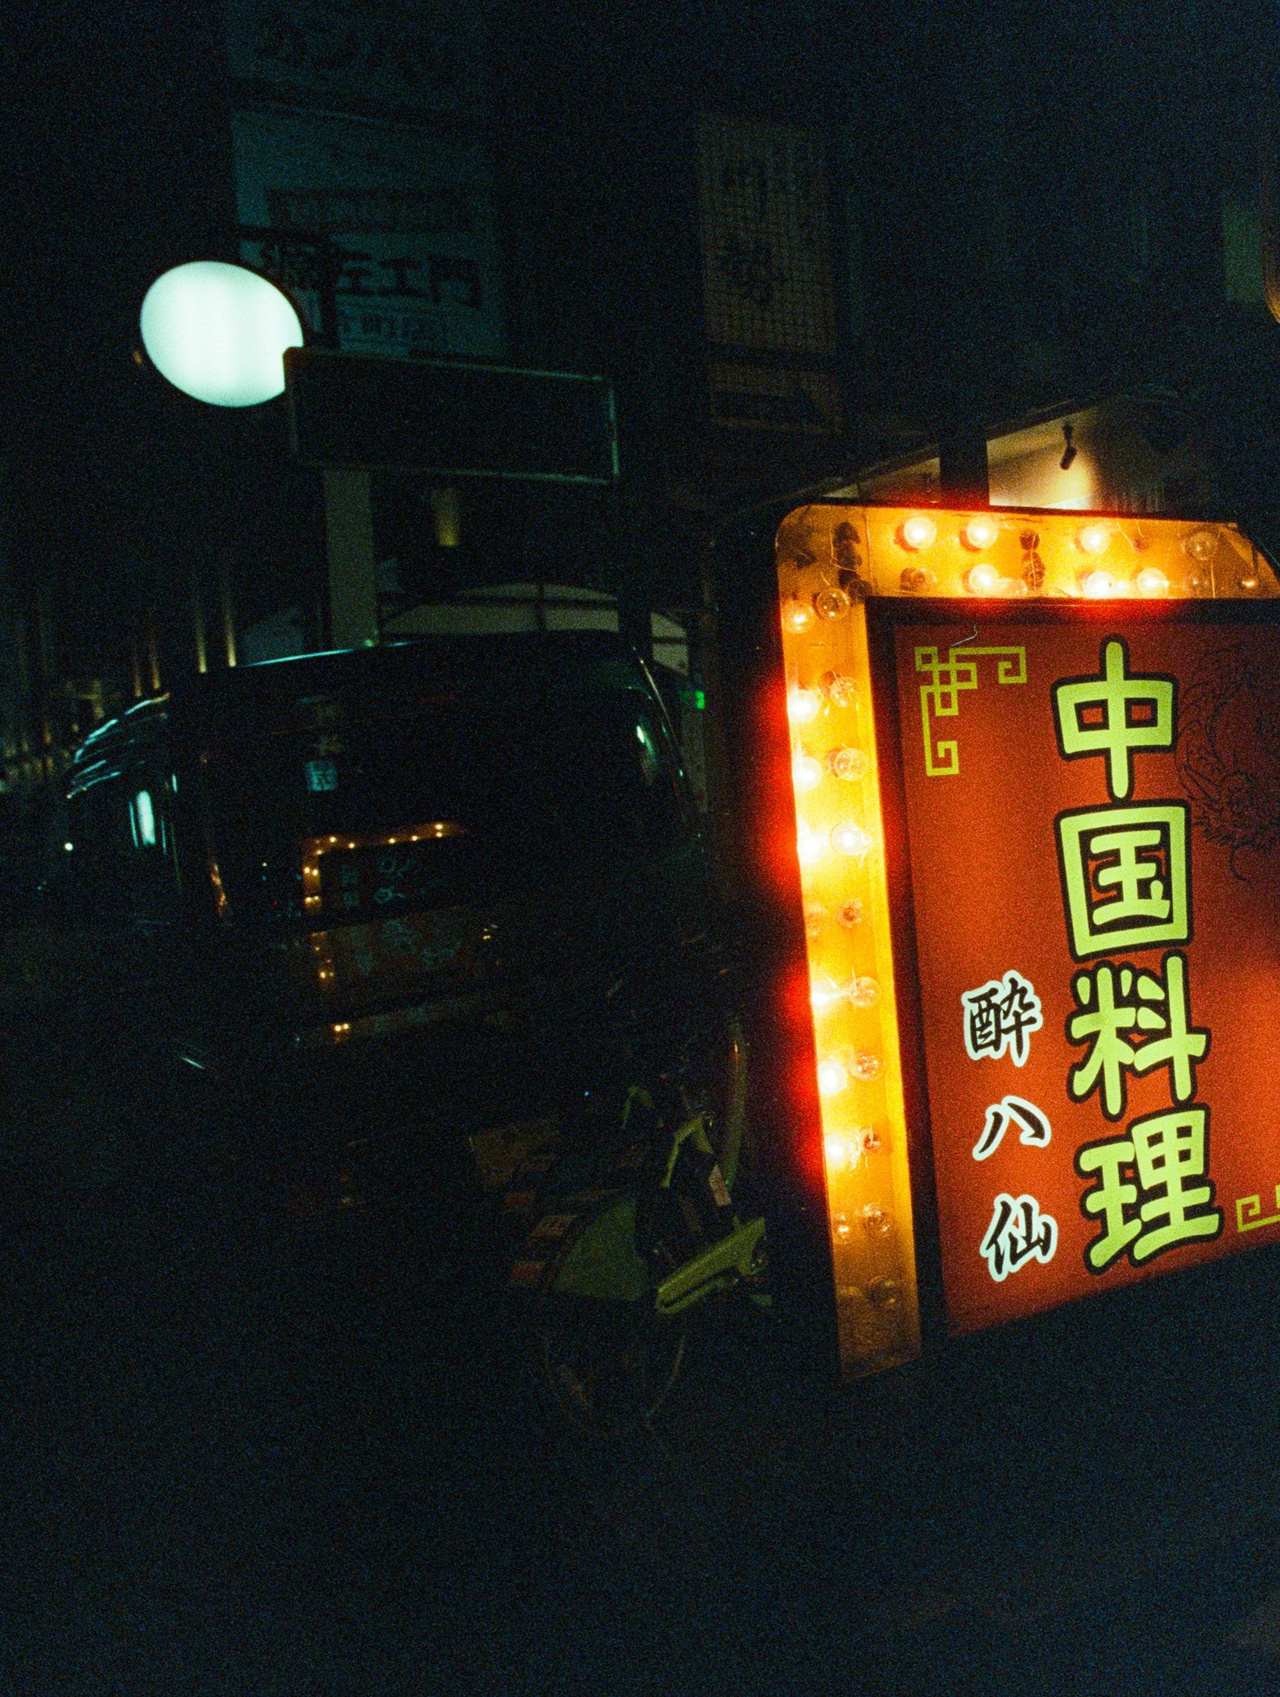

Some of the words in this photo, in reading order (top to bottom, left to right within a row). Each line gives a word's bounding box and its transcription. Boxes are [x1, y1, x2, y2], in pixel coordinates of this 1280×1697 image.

[965, 973, 1055, 1279] 酔八仙
[1053, 637, 1221, 1270] 中国料理
